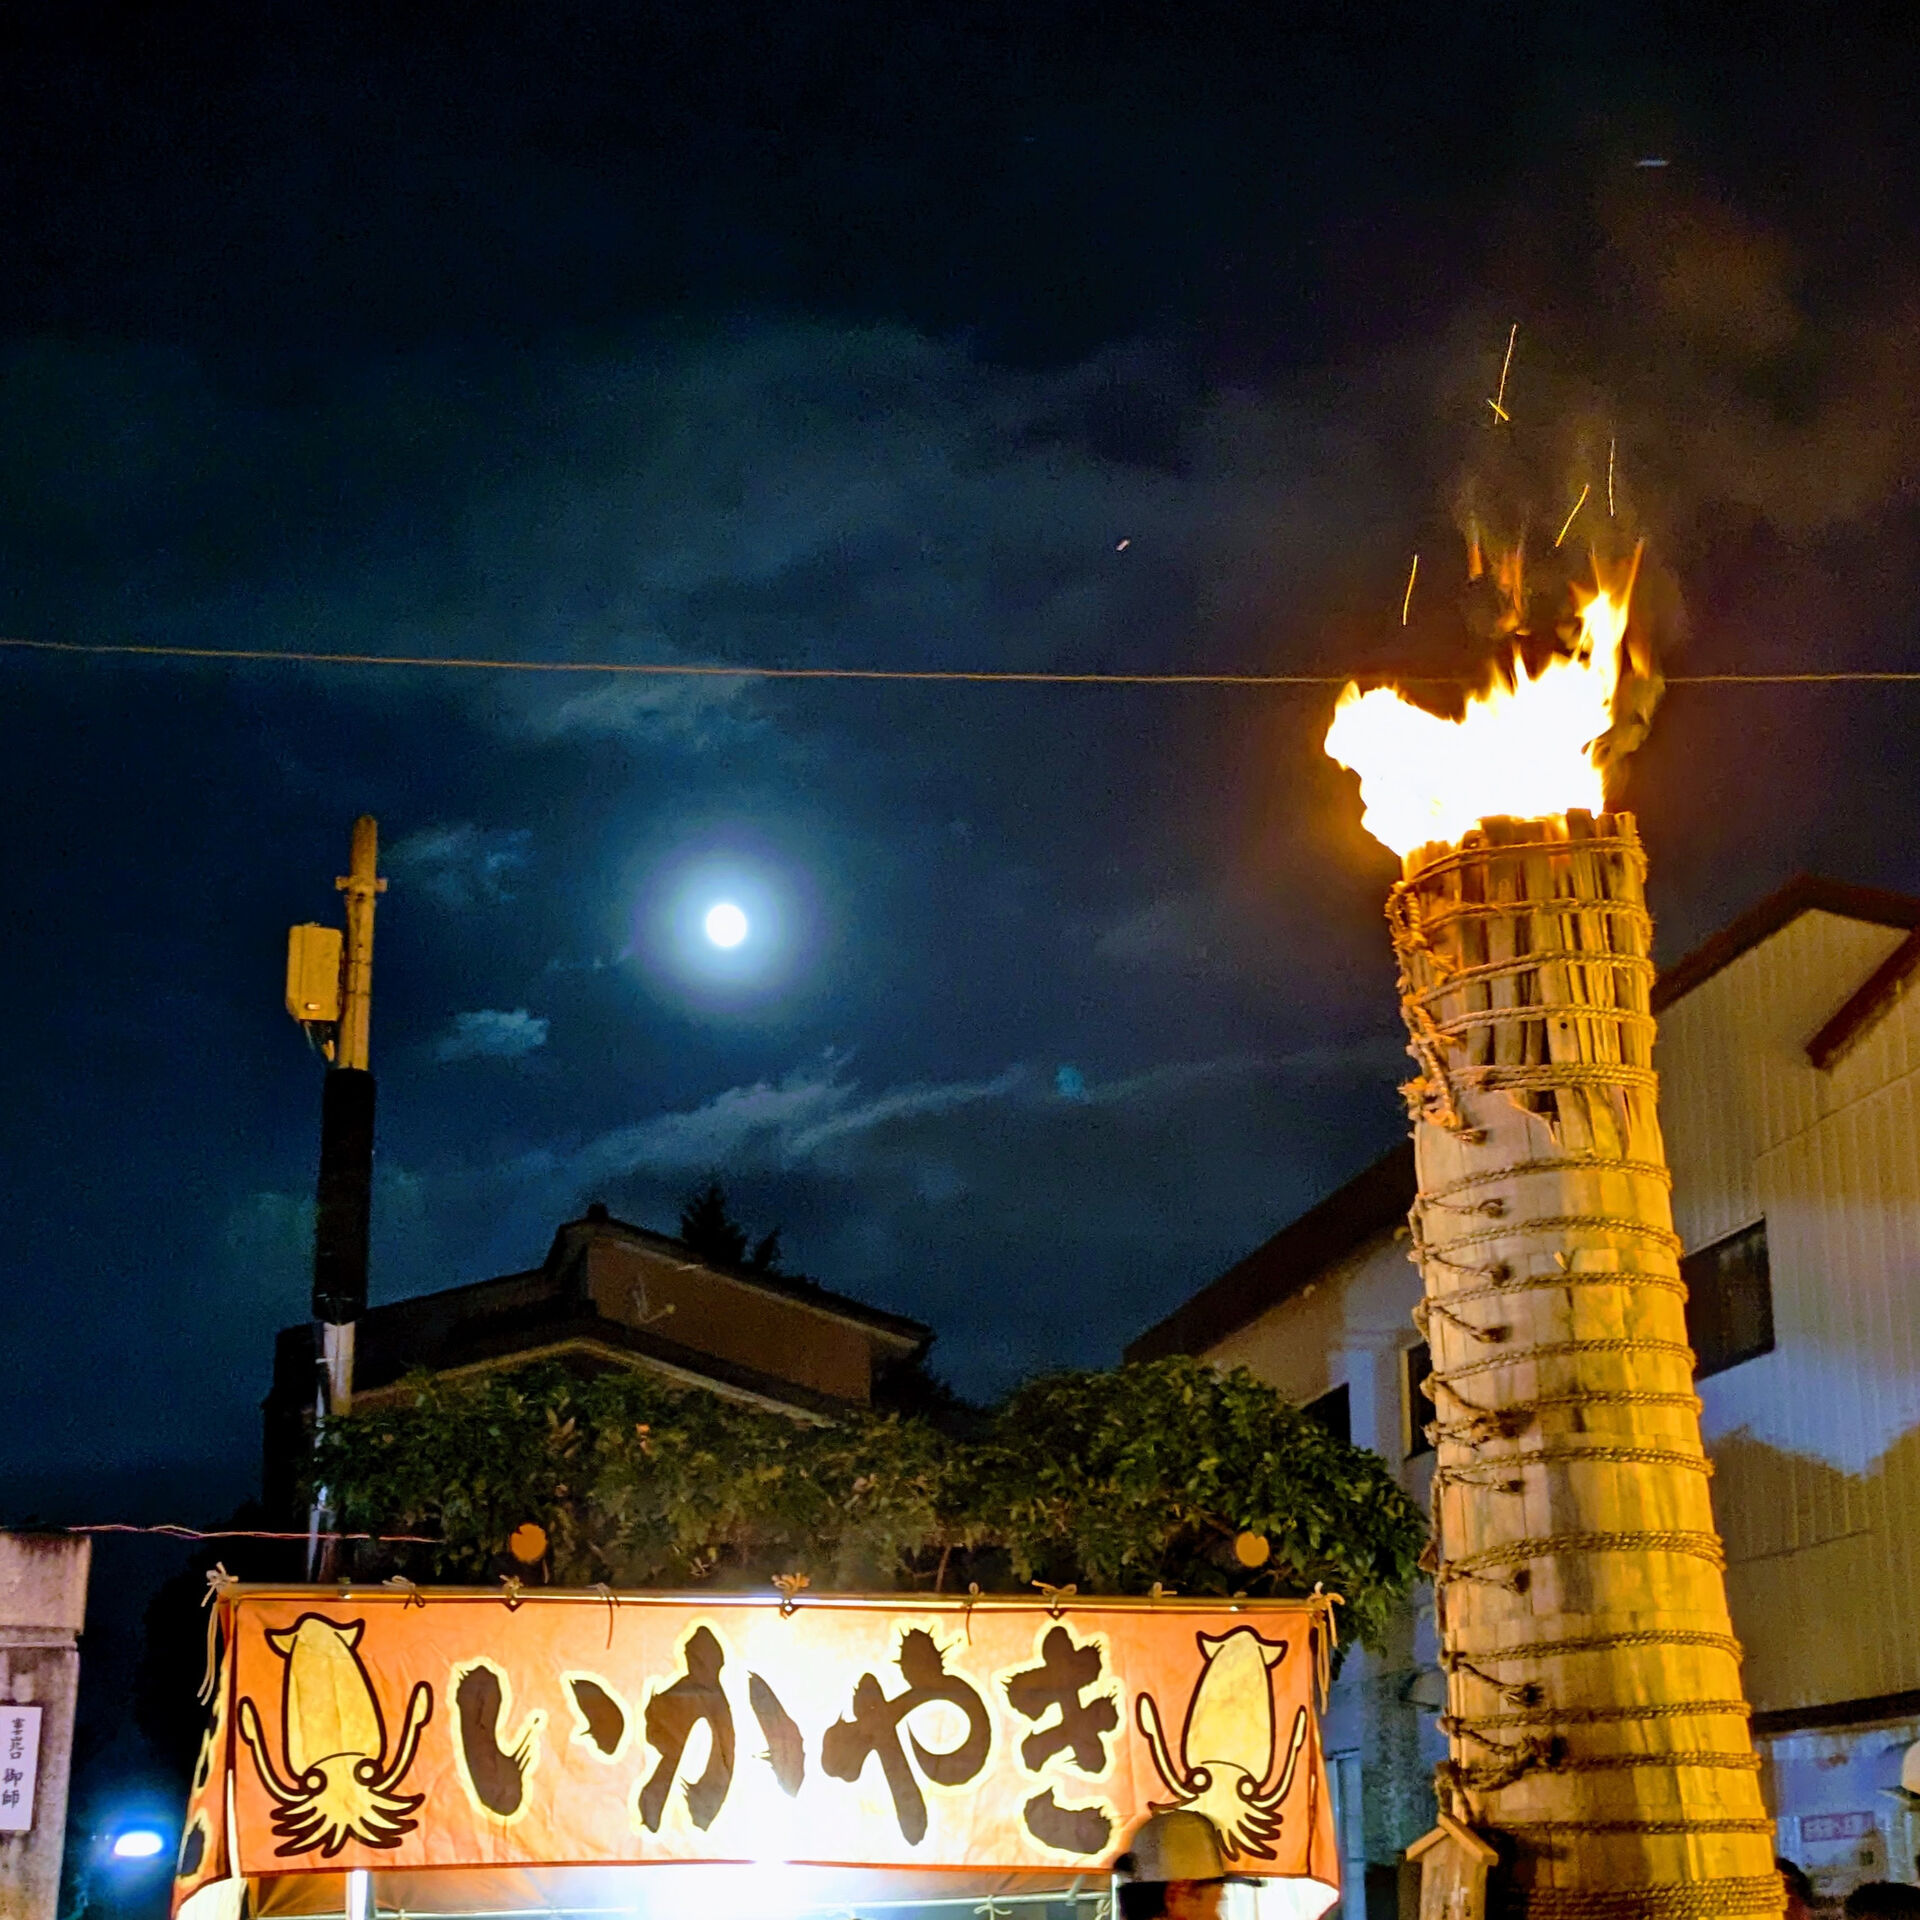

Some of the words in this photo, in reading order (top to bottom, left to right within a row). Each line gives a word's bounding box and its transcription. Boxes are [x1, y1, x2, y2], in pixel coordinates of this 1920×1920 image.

[2, 1767, 24, 1809] 御師
[456, 1625, 1118, 1854] いかやき
